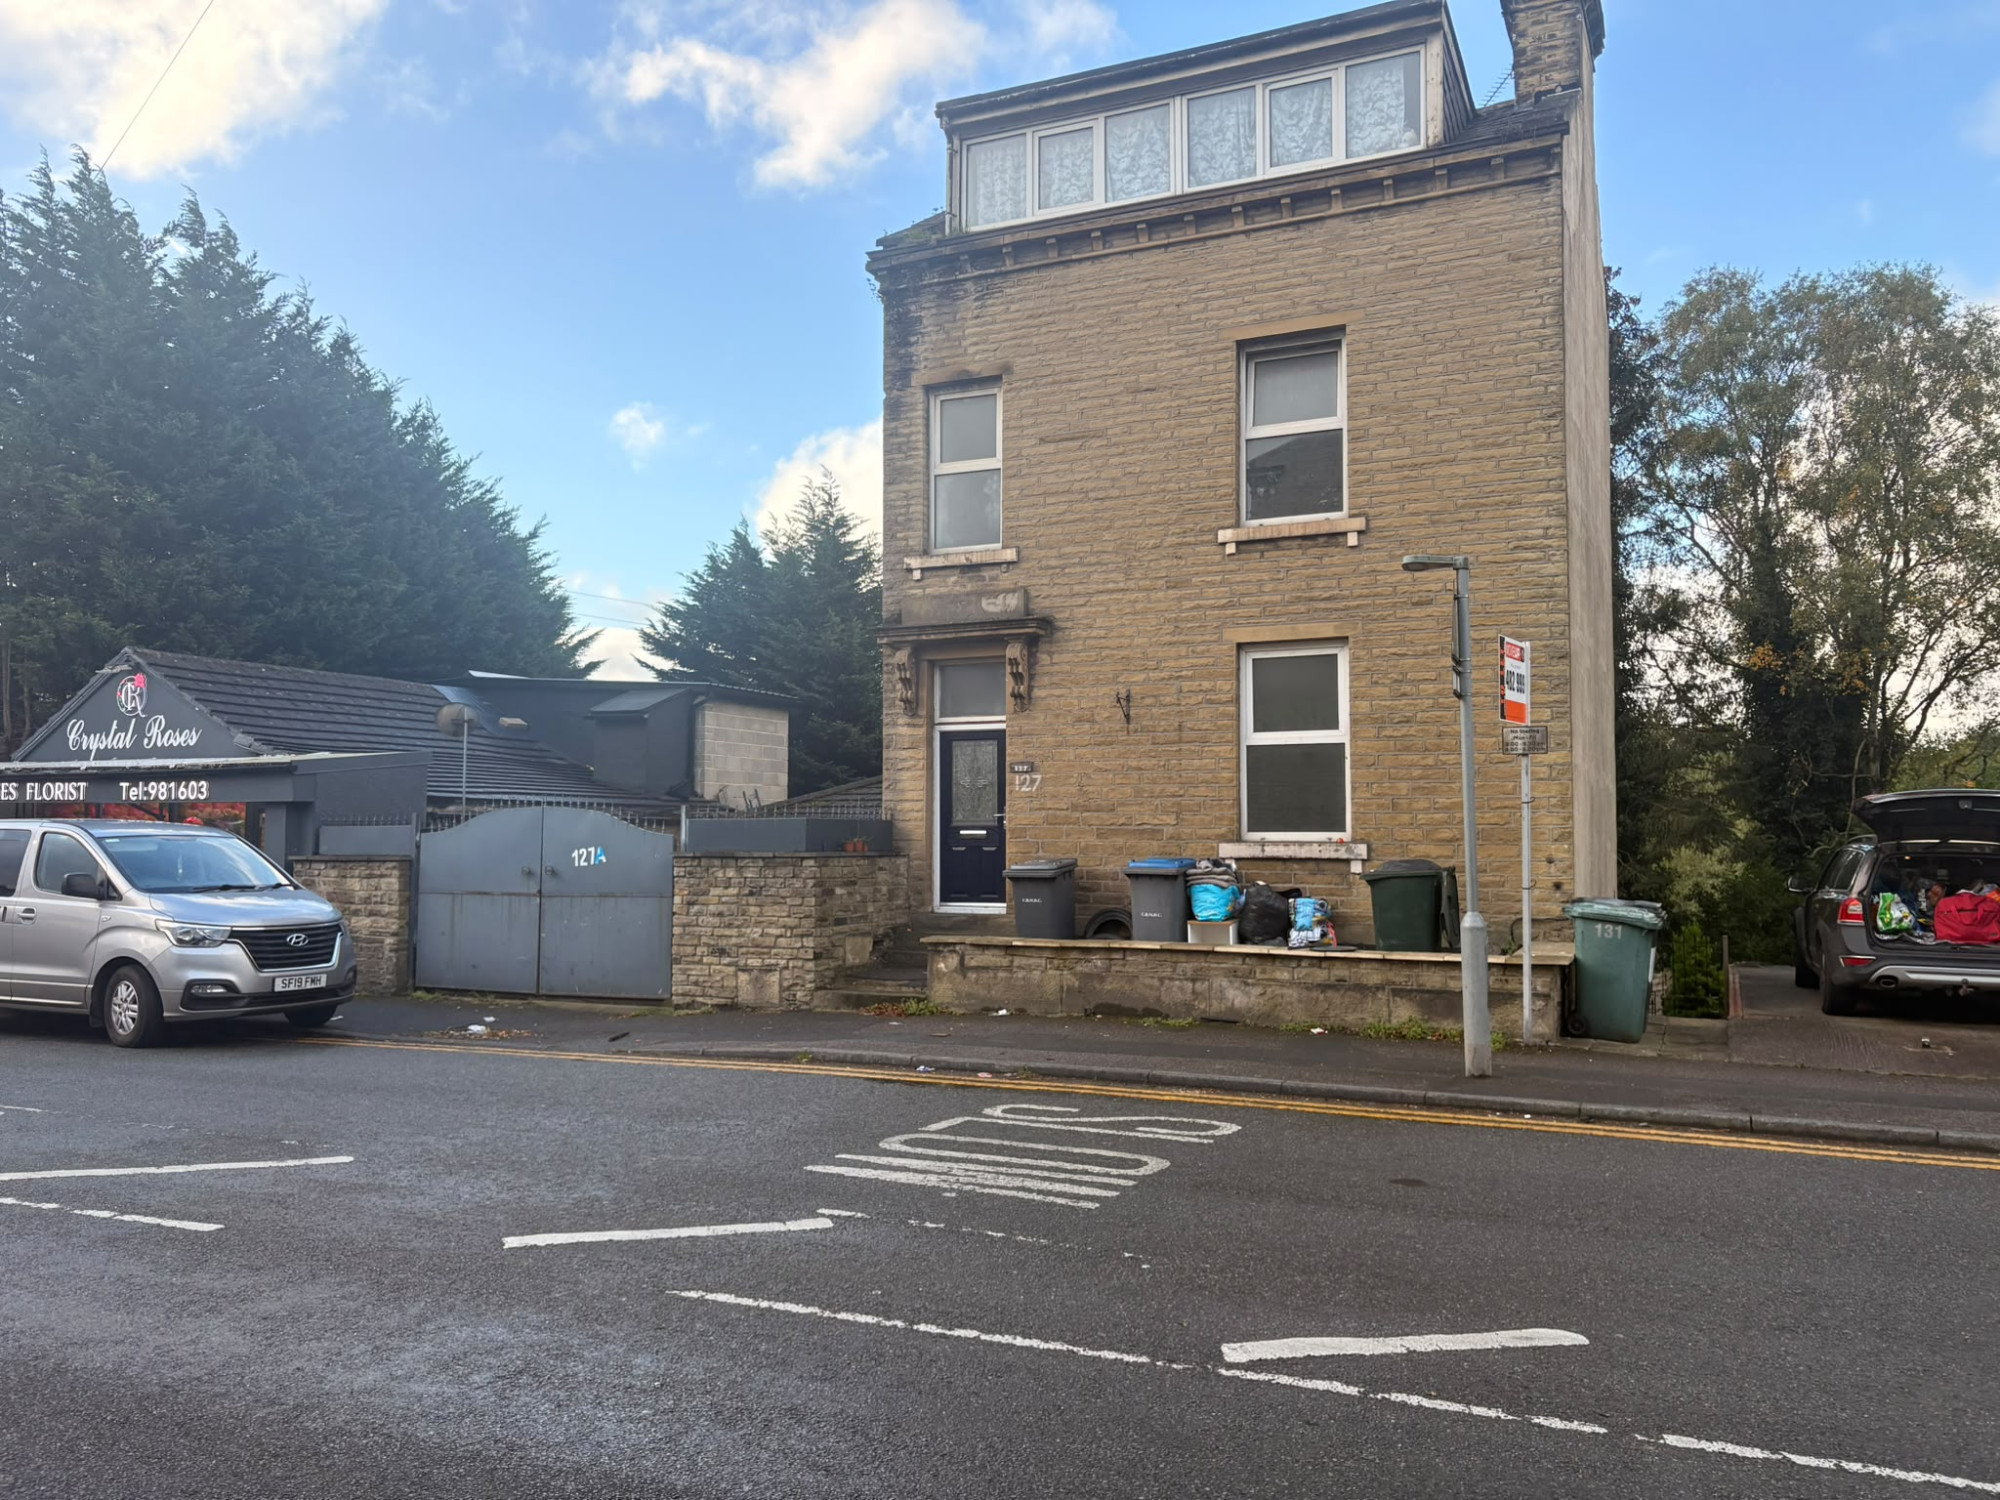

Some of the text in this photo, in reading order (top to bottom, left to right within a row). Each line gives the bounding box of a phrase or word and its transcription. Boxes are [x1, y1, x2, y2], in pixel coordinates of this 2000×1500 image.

[67, 714, 202, 761] Crystal Roses
[26, 782, 87, 801] FLORIST
[119, 781, 209, 801] Tel:981603
[1015, 774, 1042, 792] 127
[571, 845, 607, 867] 127A
[1594, 923, 1623, 939] 131
[281, 976, 322, 989] SF19 FMH
